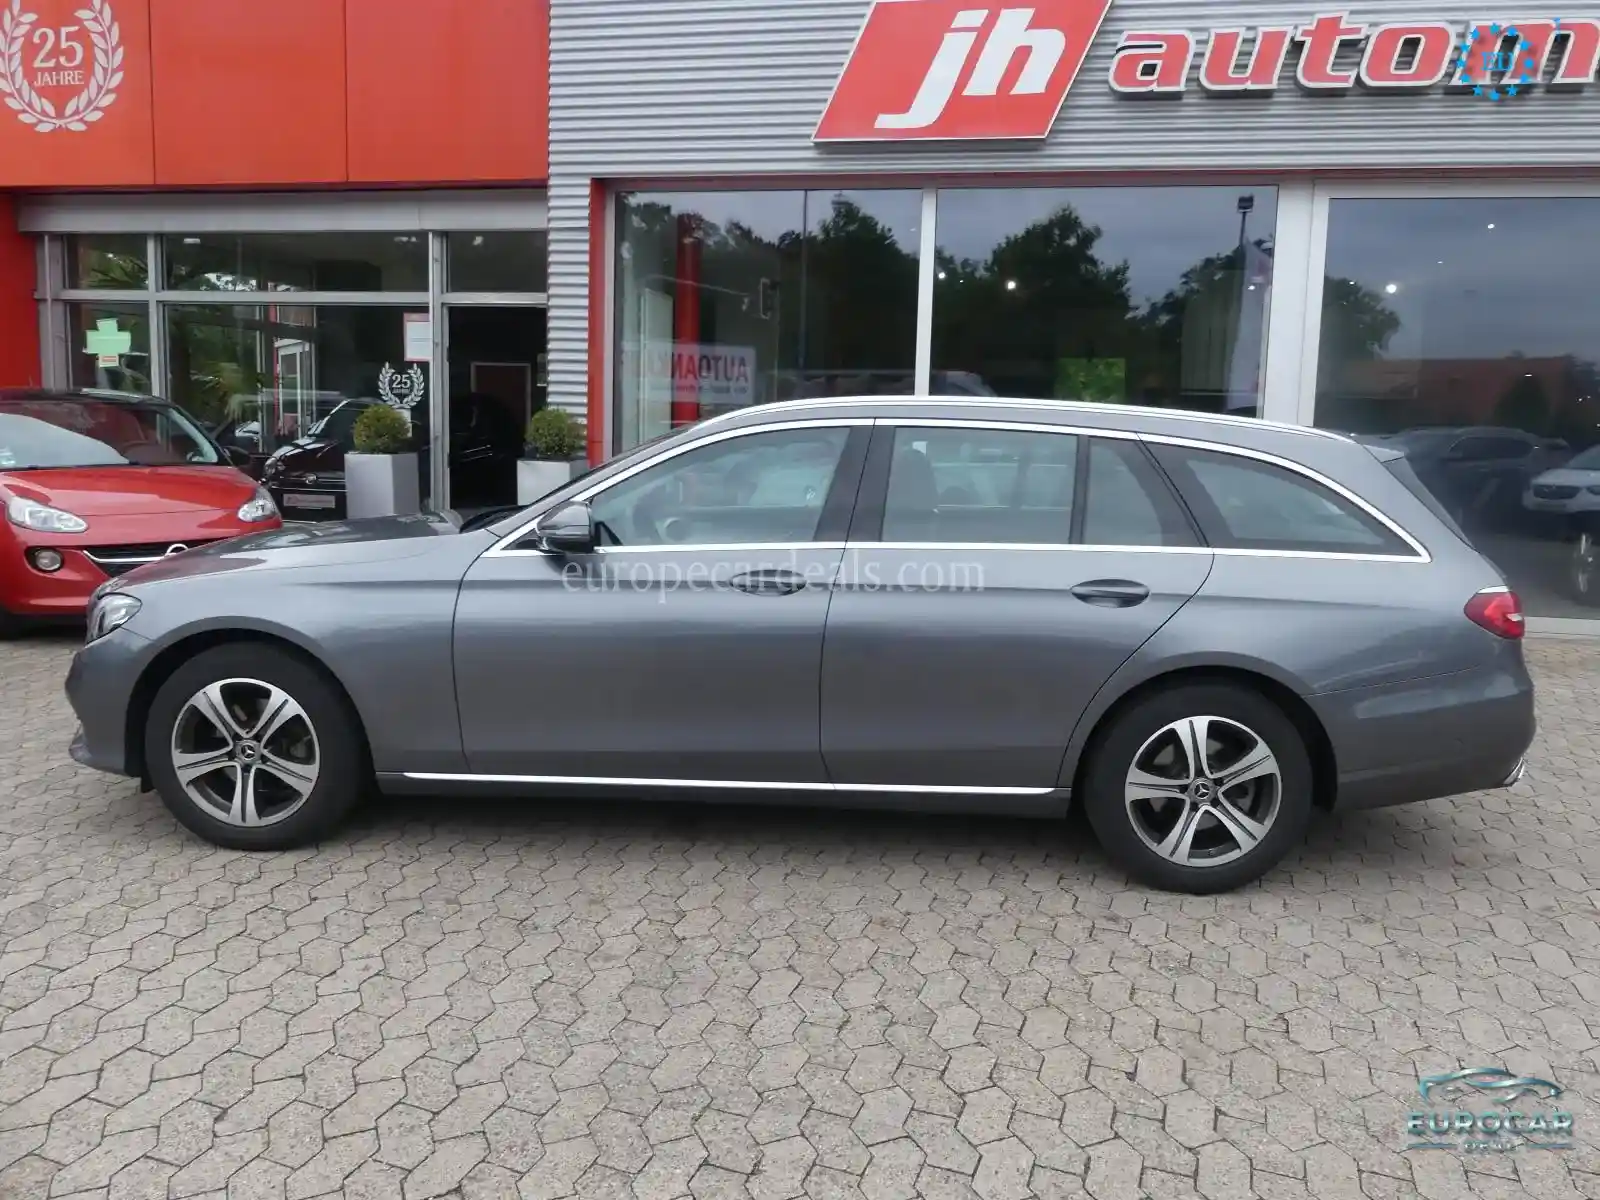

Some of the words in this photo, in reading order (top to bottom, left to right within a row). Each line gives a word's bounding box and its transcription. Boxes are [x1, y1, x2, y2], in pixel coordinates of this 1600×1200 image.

[32, 25, 84, 68] 25
[34, 70, 85, 86] JAHRE
[874, 7, 1066, 129] jh
[392, 374, 411, 389] 25
